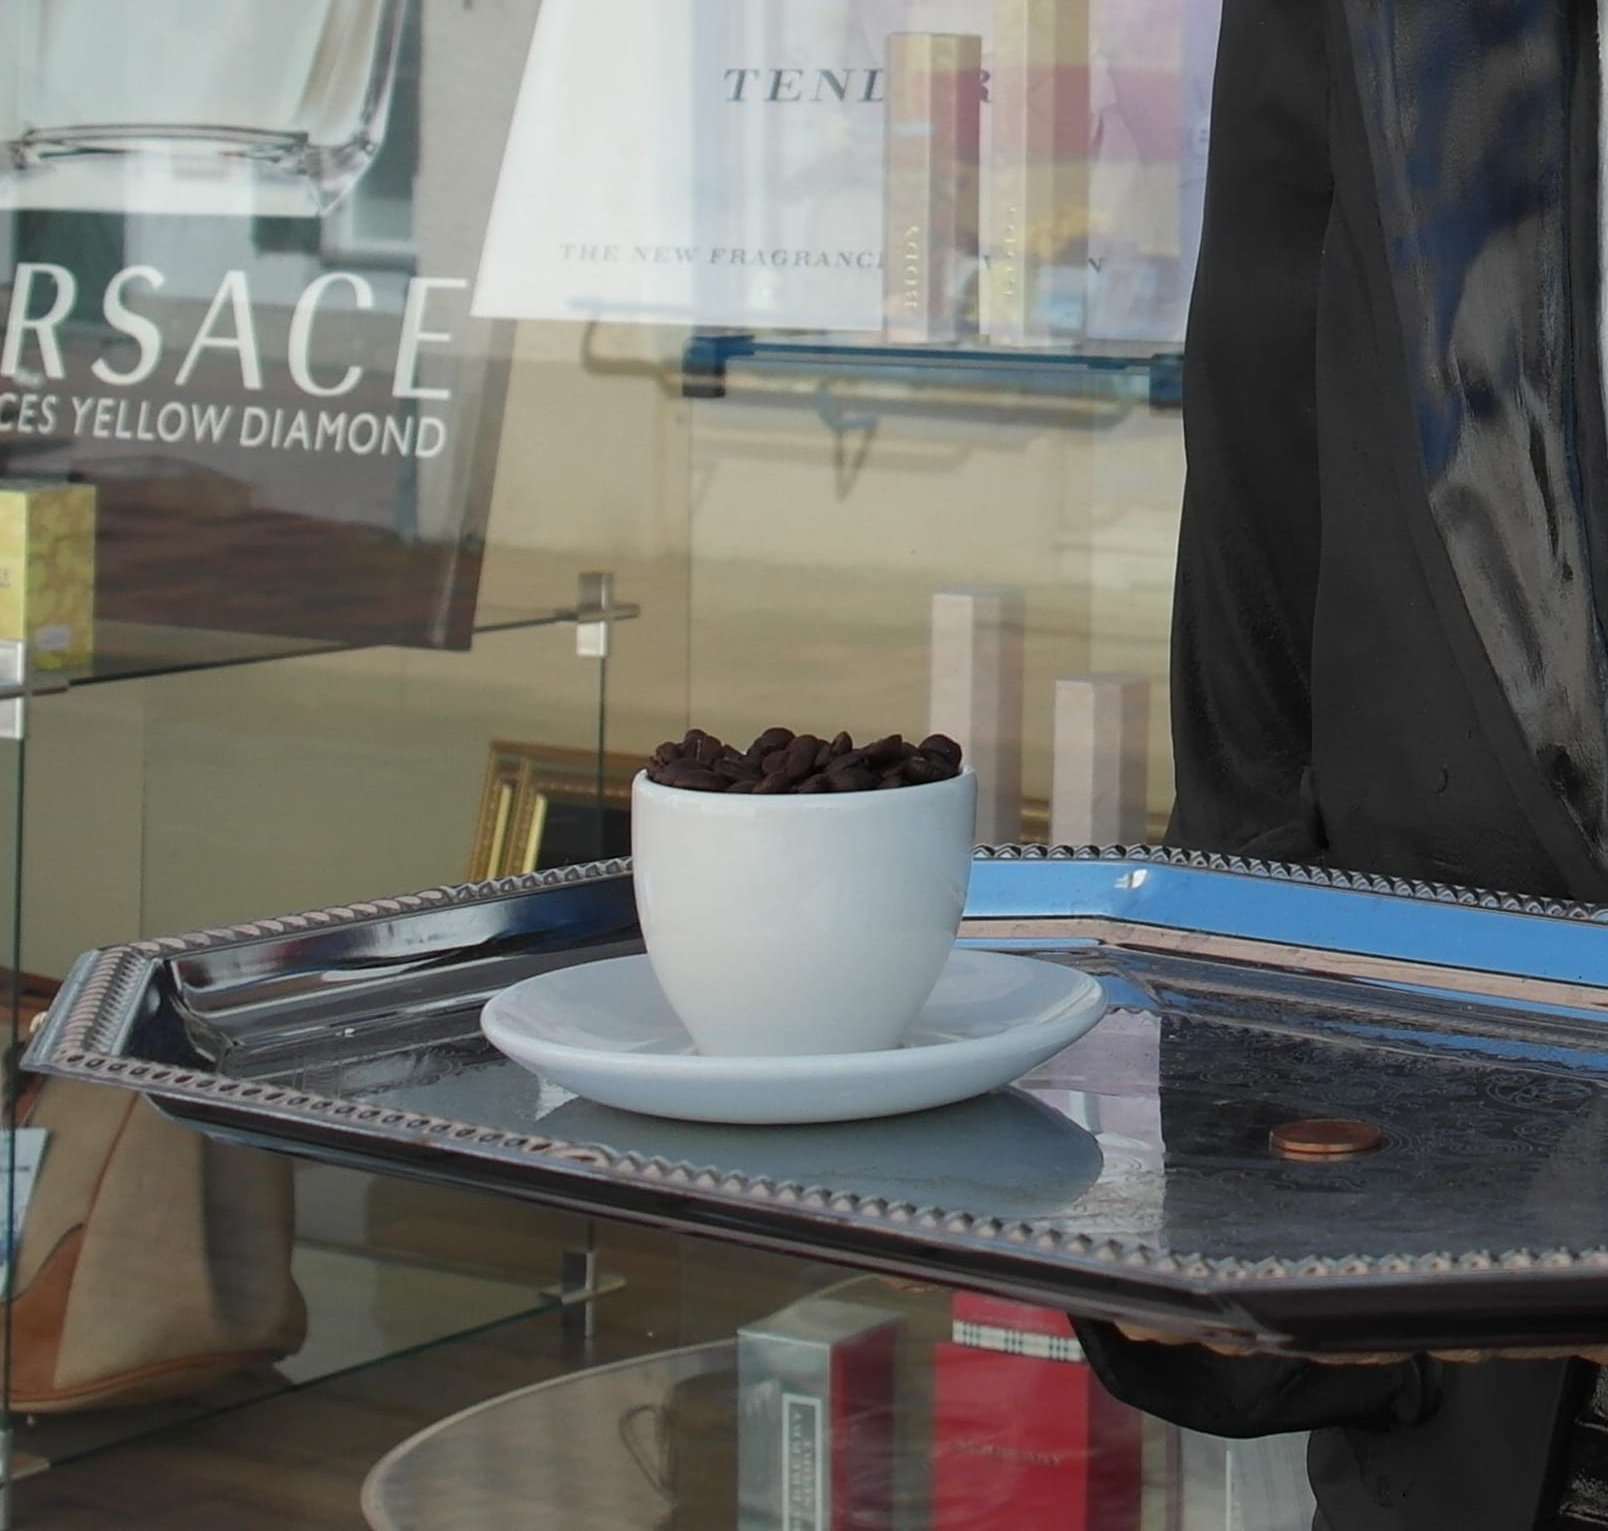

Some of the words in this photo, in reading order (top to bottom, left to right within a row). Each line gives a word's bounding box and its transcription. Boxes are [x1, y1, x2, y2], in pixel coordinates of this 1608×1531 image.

[558, 242, 621, 263] THE
[632, 244, 701, 265] NEW
[707, 246, 883, 270] FRAGRANC
[0, 263, 468, 399] RSACE
[71, 396, 232, 445] YELLOW
[238, 405, 448, 459] DIAMOND
